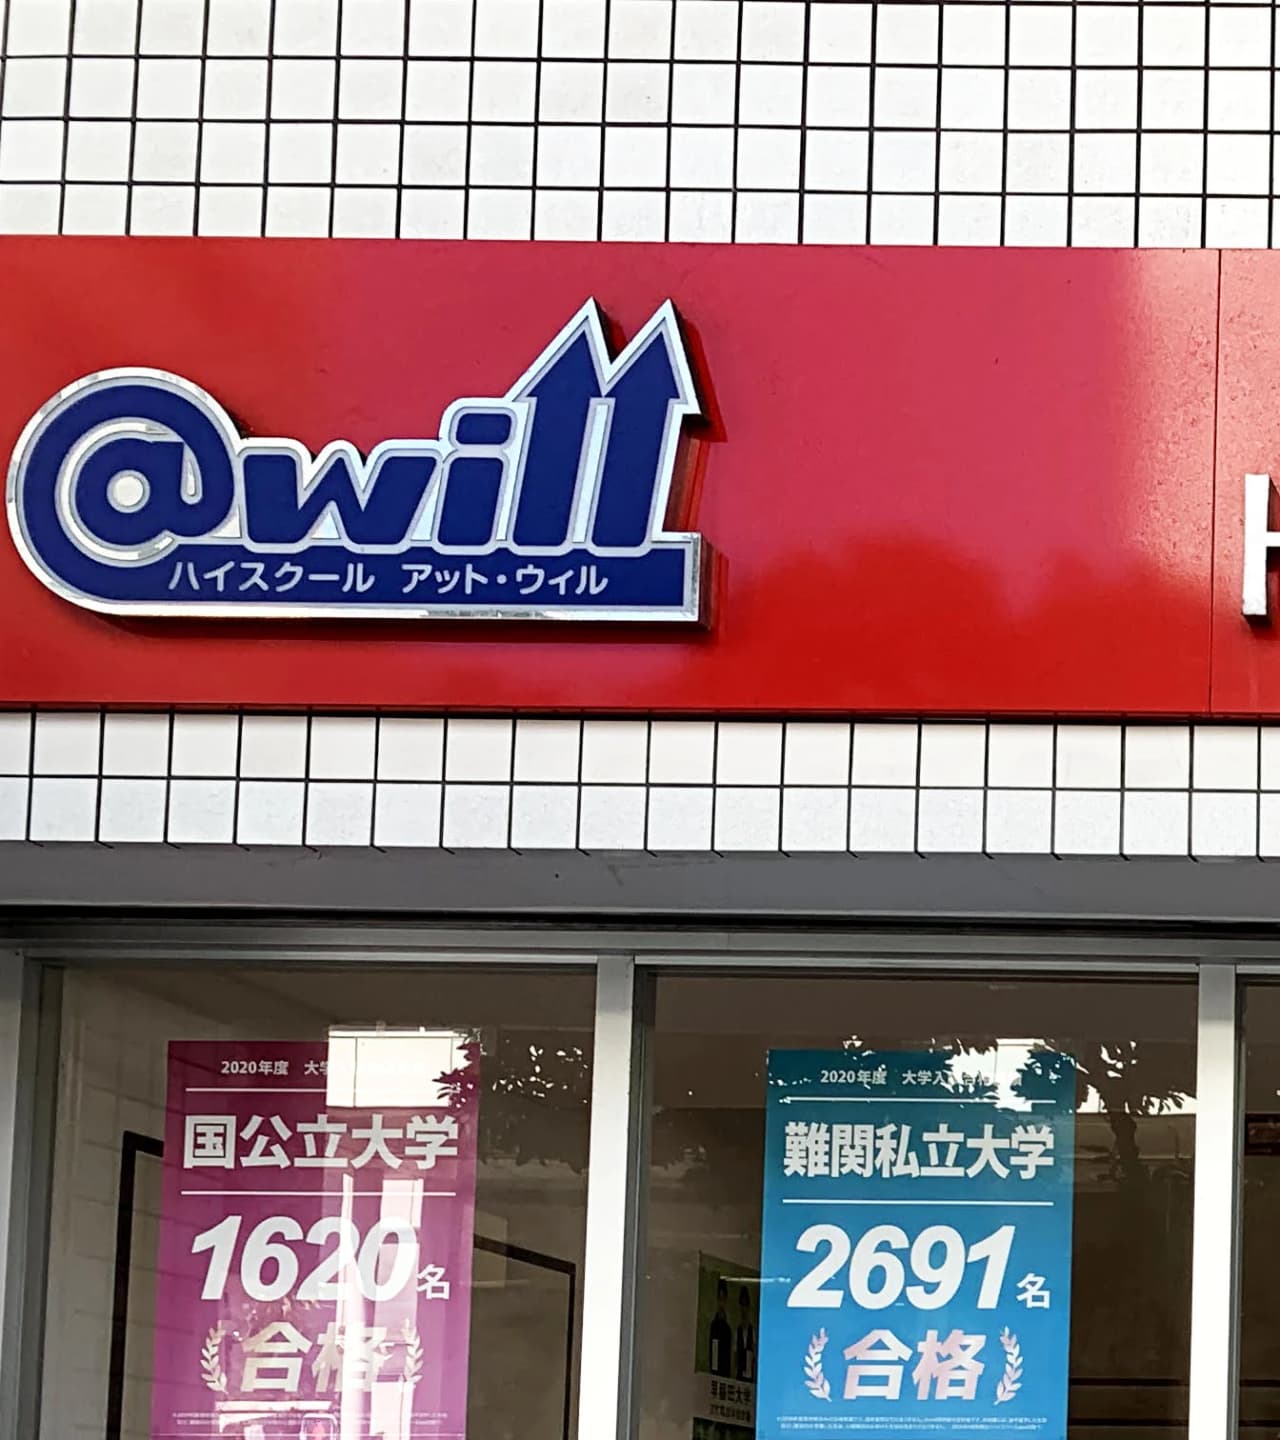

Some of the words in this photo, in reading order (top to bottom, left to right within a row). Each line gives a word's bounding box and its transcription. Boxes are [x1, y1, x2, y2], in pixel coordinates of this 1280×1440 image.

[15, 312, 682, 554] @will
[168, 561, 375, 593] ハイスクール
[401, 563, 608, 595] アット・ウィル
[819, 1069, 888, 1086] 2020年度
[182, 1113, 460, 1170] 国公立大学
[783, 1121, 1055, 1180] 難関私立大学
[786, 1222, 1051, 1311] 2691名
[843, 1328, 987, 1401] 合格
